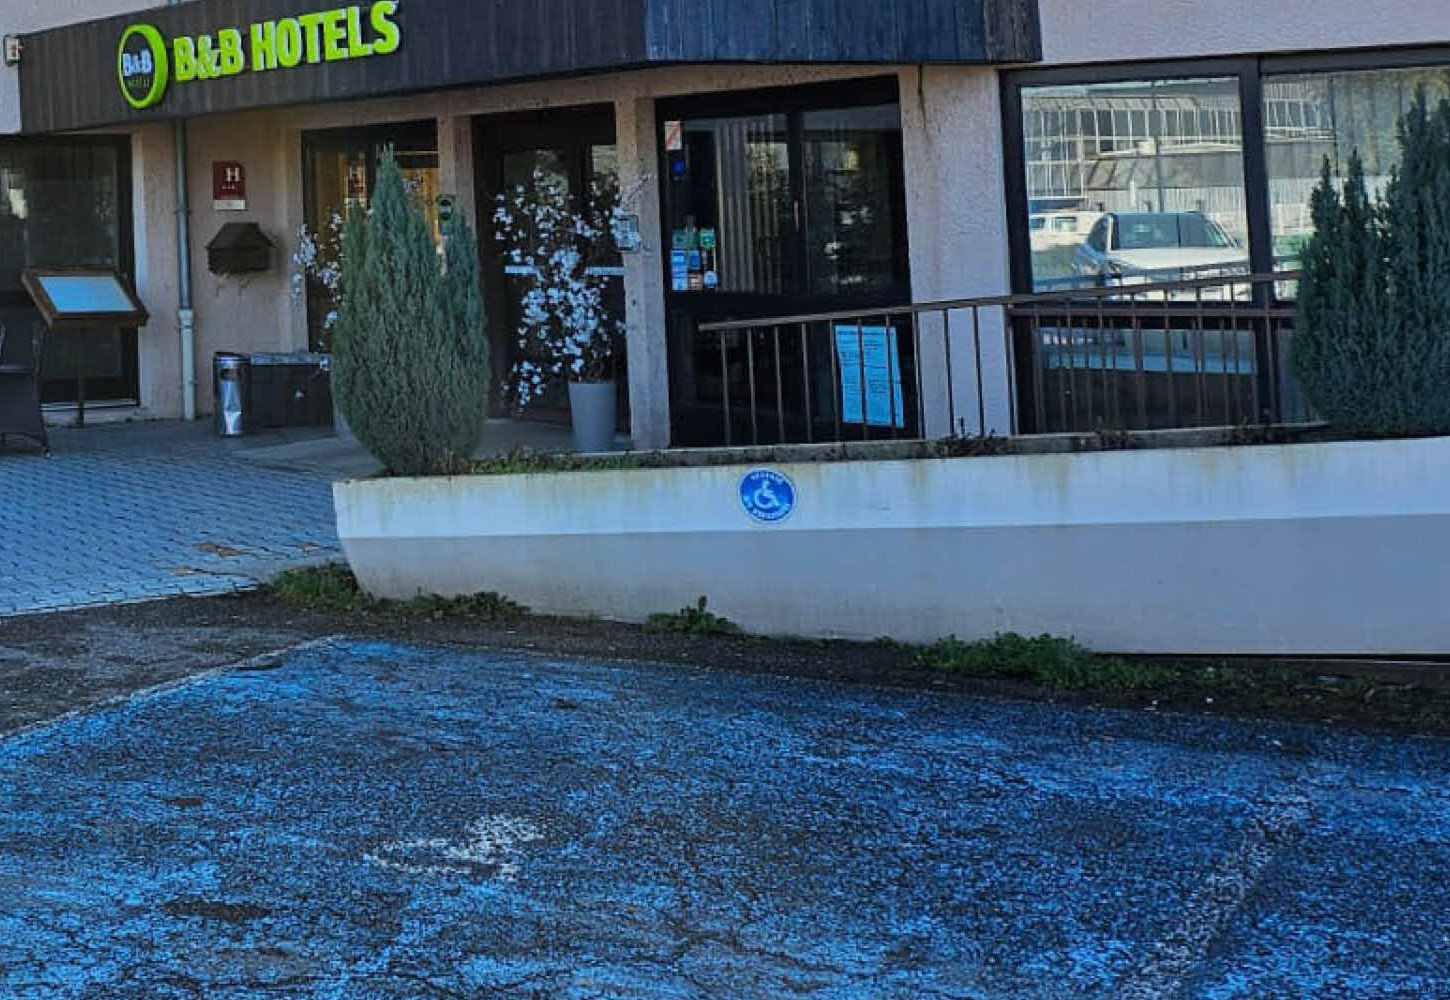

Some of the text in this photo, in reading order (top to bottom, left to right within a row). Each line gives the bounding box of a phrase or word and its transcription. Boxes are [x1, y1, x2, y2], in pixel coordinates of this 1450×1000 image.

[173, 0, 400, 81] B&B HOTELS
[122, 49, 152, 77] B&B
[225, 167, 241, 182] H
